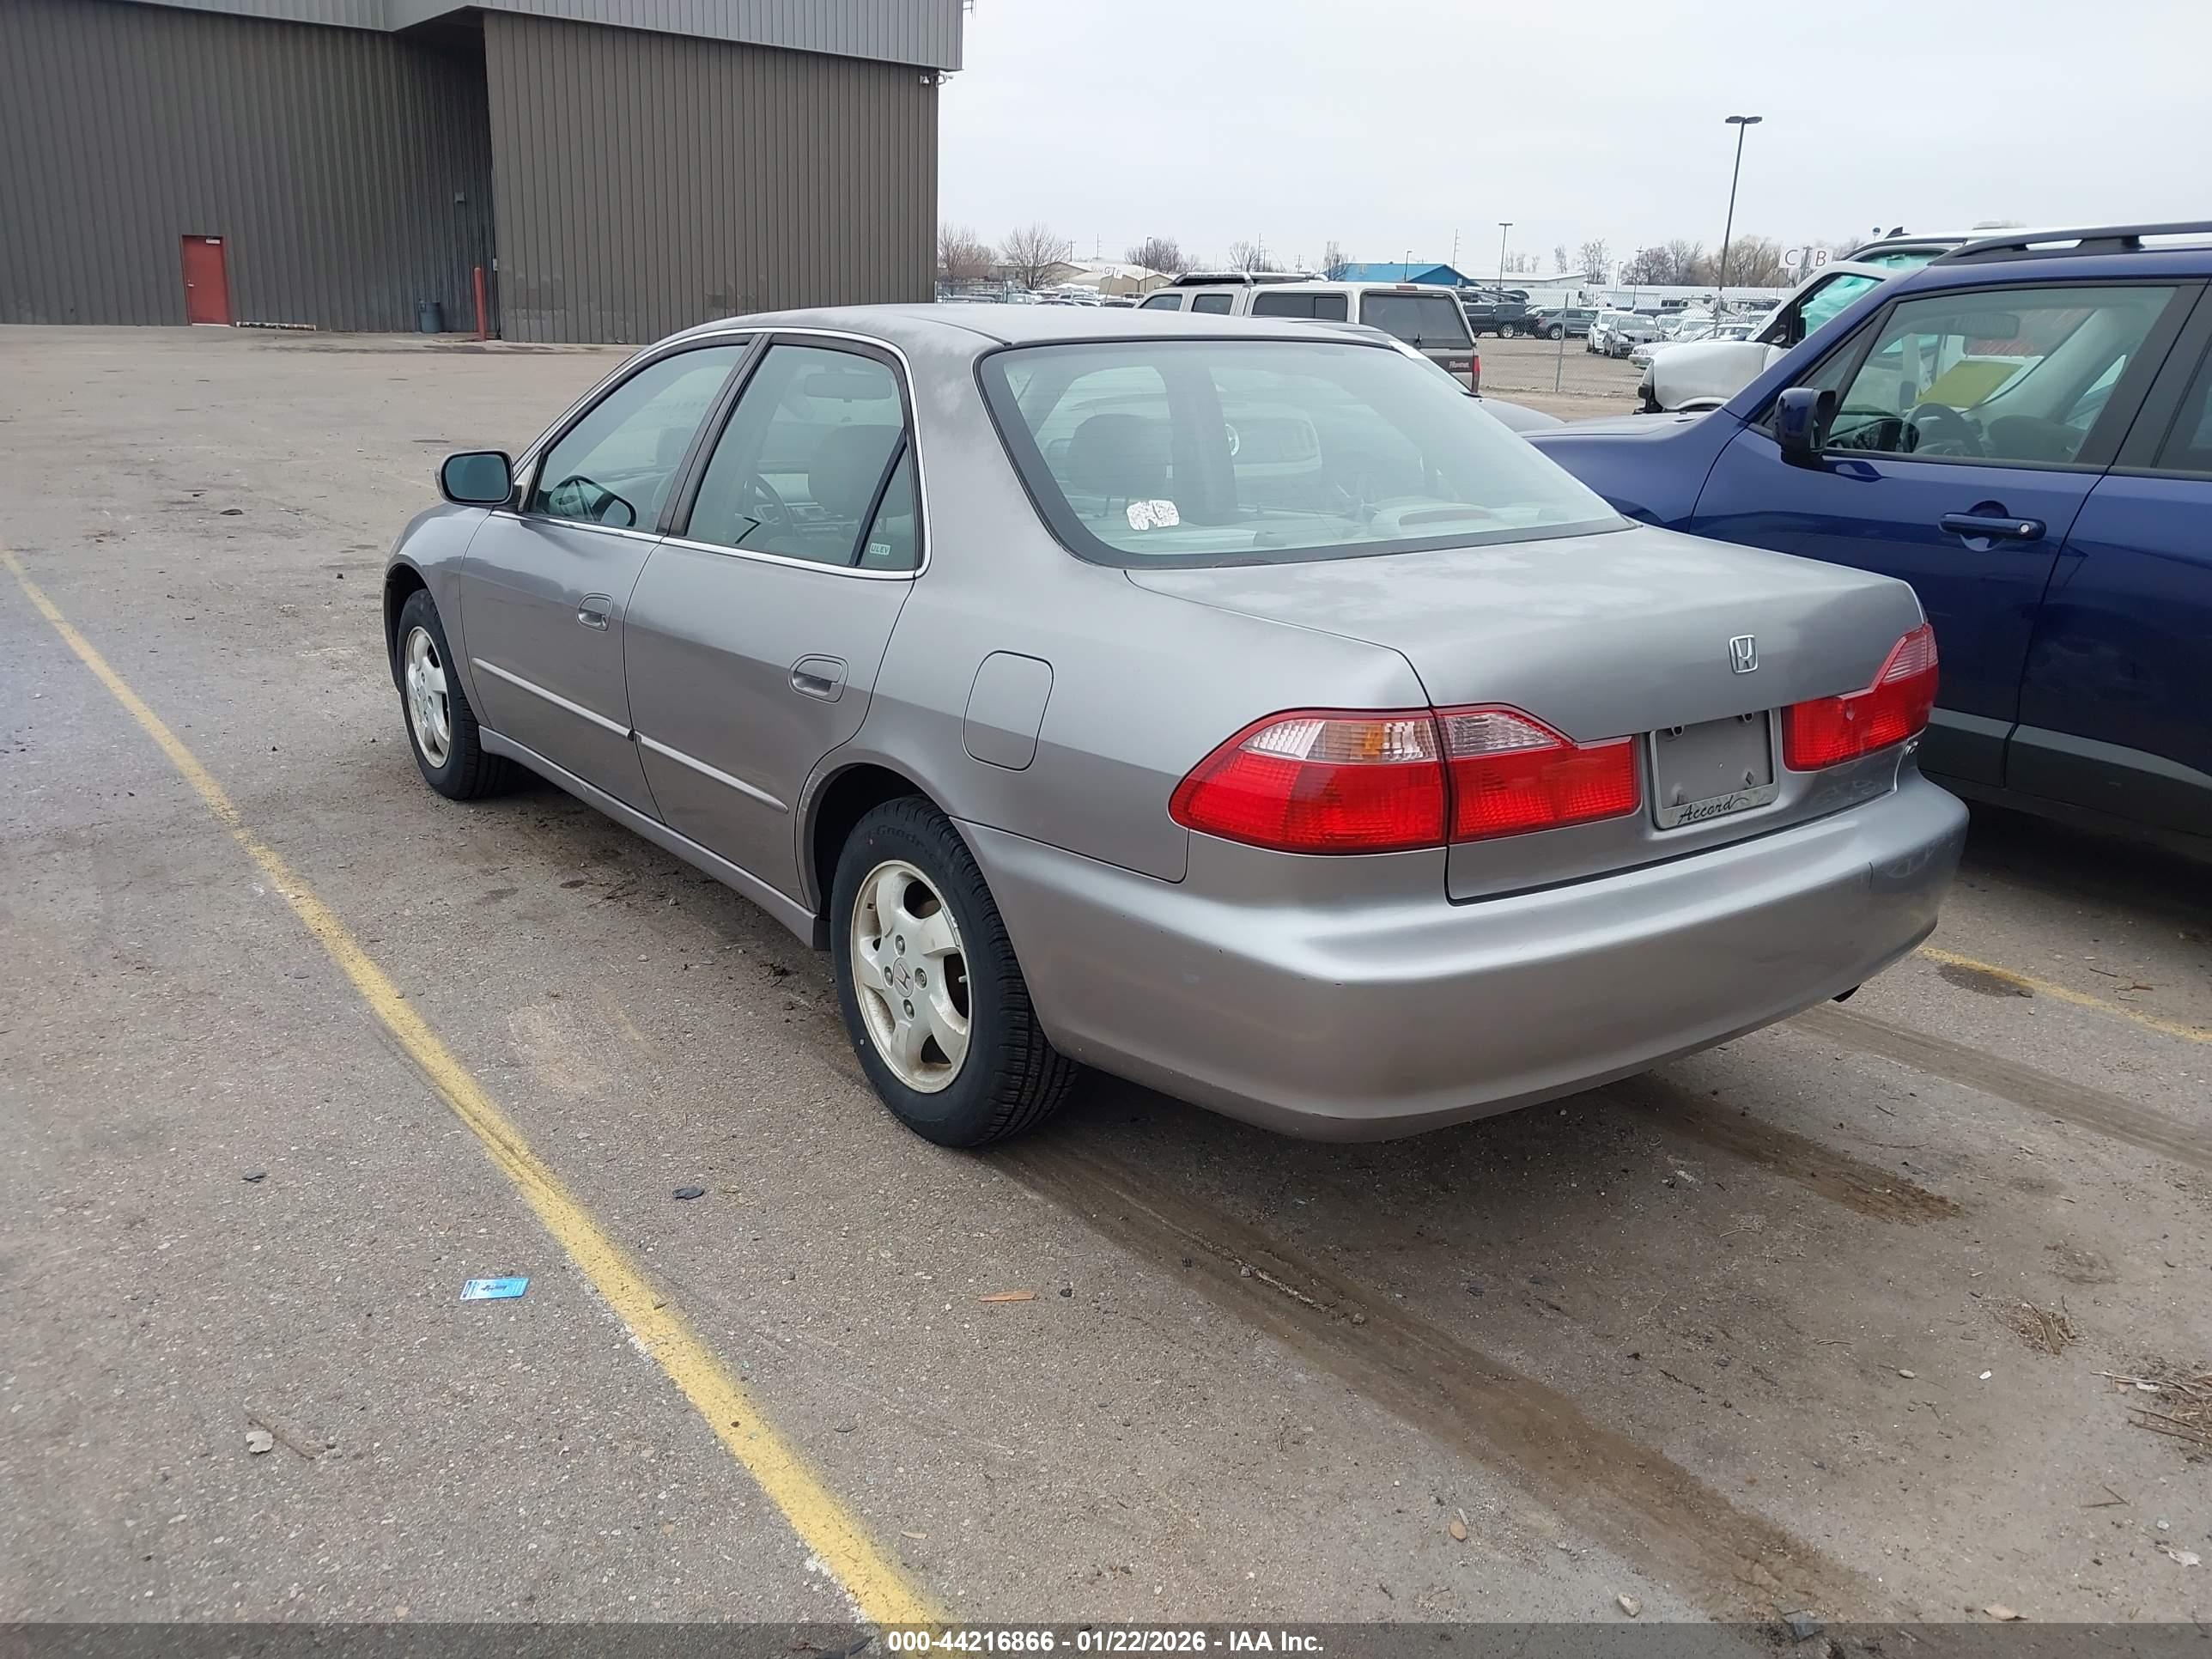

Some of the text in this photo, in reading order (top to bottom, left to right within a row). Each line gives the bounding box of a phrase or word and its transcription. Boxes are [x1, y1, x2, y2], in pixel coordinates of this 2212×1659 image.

[1784, 249, 1798, 266] C
[1815, 250, 1827, 267] B
[871, 544, 890, 555] ULEV
[1677, 795, 1748, 824] Accord
